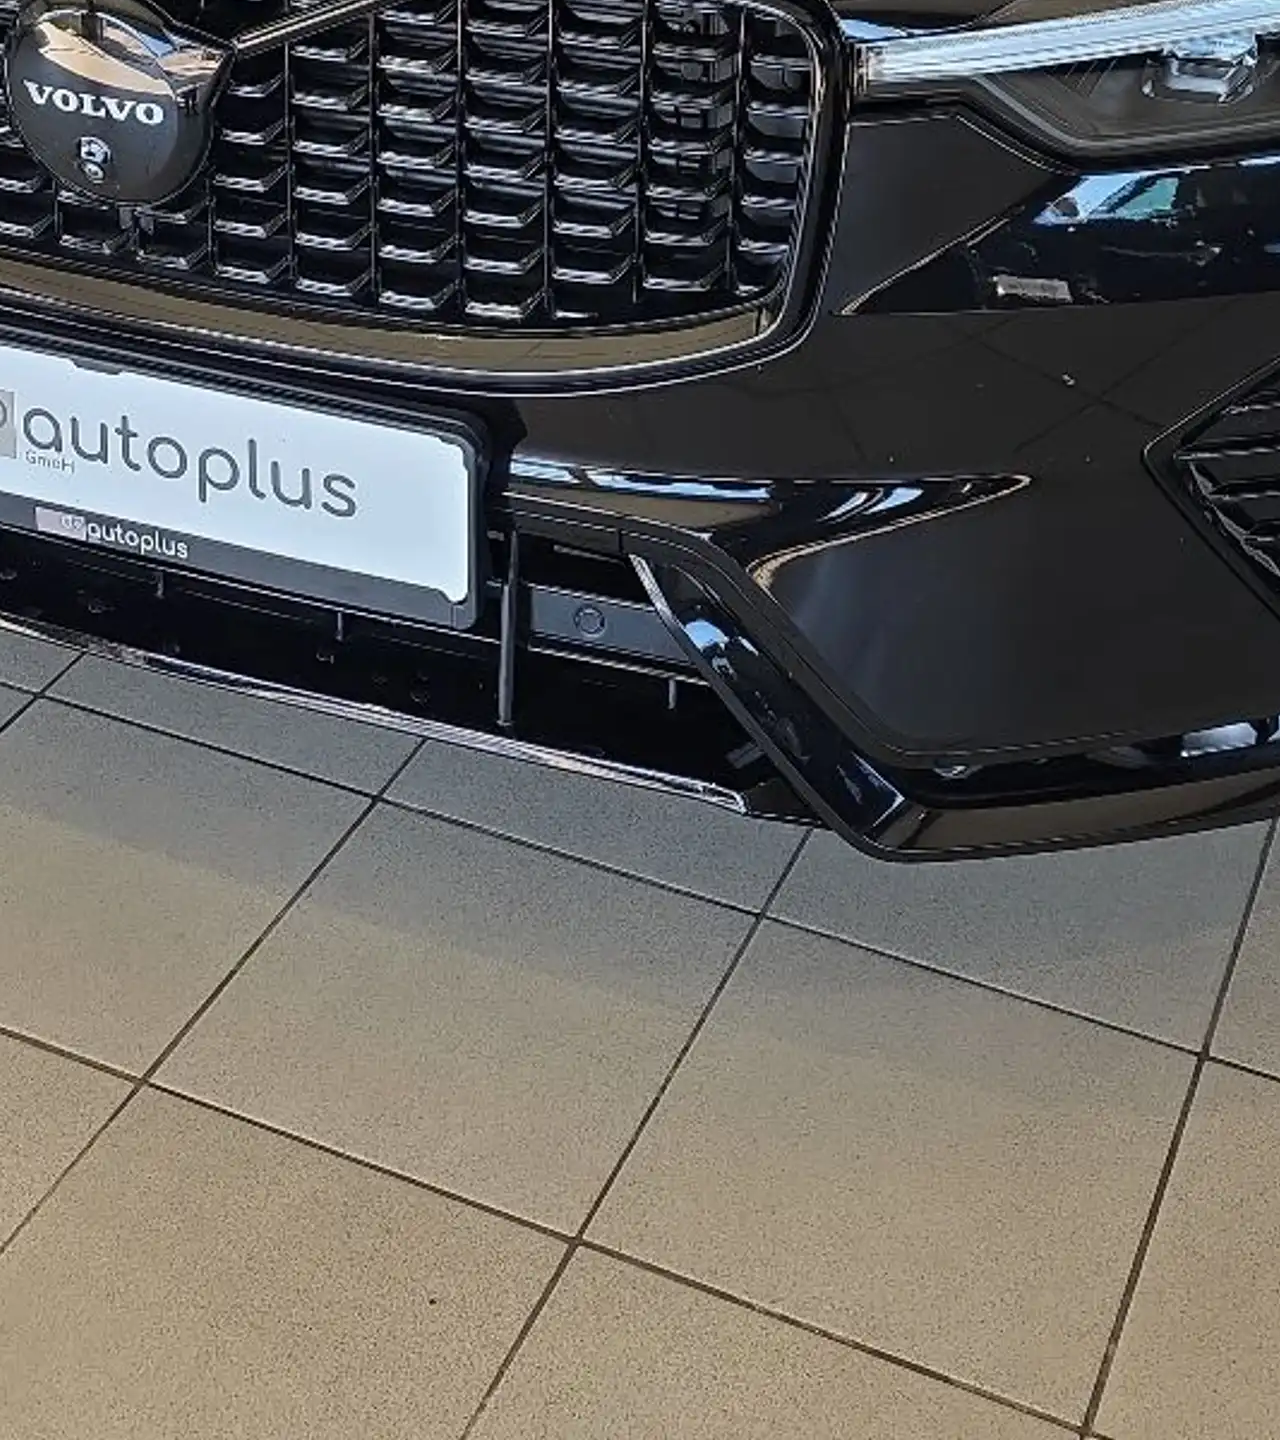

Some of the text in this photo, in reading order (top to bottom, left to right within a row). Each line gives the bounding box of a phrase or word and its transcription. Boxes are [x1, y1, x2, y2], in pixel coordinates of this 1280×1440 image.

[23, 78, 164, 125] VOLVO
[23, 407, 358, 518] autoplus
[87, 522, 188, 559] autoplus
